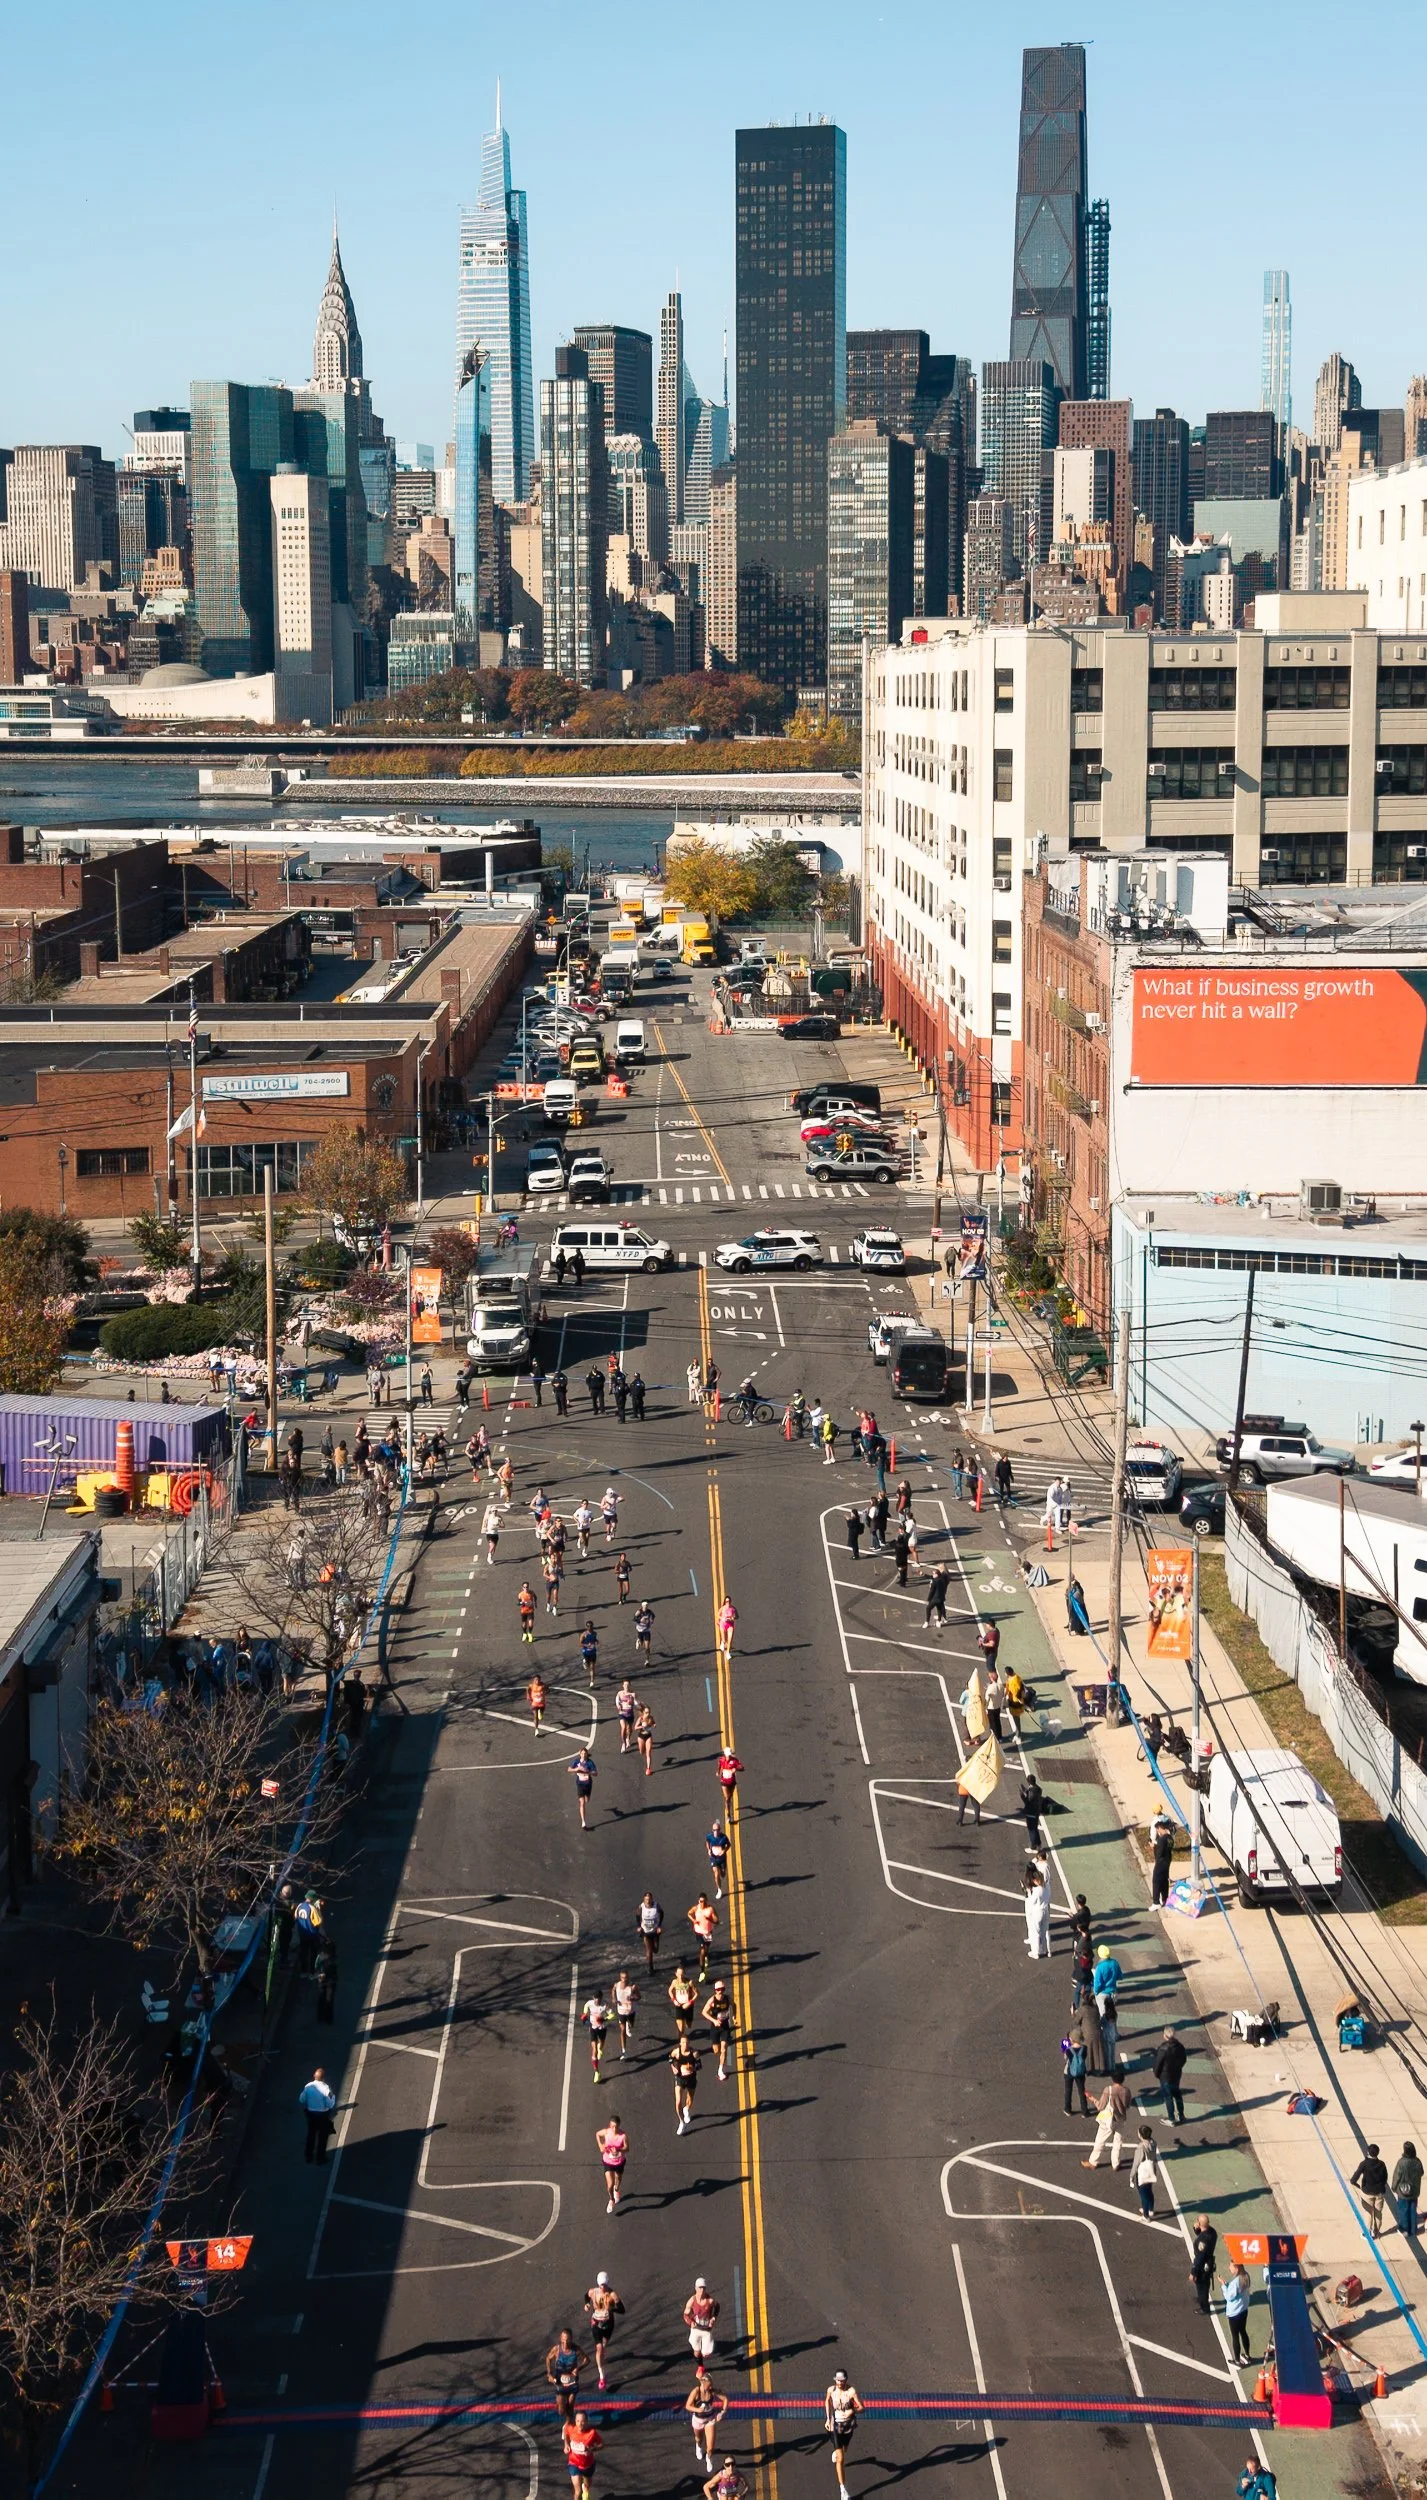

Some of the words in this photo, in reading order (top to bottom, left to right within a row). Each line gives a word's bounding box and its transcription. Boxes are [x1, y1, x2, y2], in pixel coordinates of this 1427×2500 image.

[1143, 978, 1193, 996] What
[1199, 978, 1212, 996] if
[1216, 978, 1299, 996] business
[1304, 978, 1374, 1000] growth
[1141, 1004, 1196, 1019] never
[1201, 1002, 1227, 1019] hit
[1232, 1005, 1243, 1019] a
[1248, 1002, 1298, 1019] wall?
[675, 1153, 711, 1162] ONLY
[710, 1306, 764, 1320] ONLY
[1151, 1574, 1175, 1583] NOV
[1176, 1574, 1189, 1583] 02
[214, 2244, 236, 2259] 14
[1240, 2239, 1261, 2254] 14
